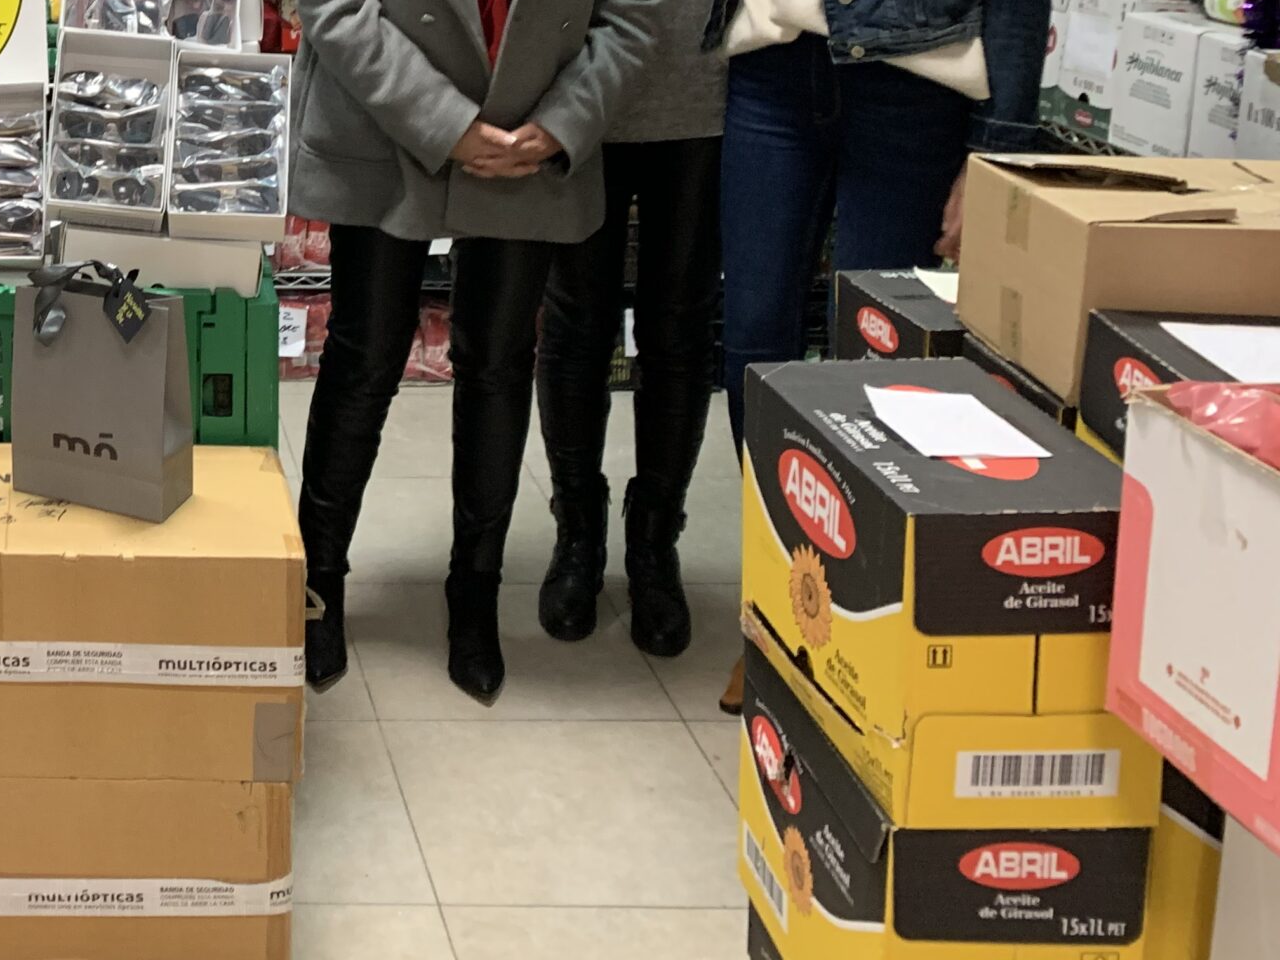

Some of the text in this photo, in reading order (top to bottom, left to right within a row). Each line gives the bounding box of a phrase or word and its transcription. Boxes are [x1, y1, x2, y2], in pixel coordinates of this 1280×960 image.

[861, 309, 894, 349] ABRIL
[785, 456, 846, 553] ABRIL
[995, 536, 1091, 566] ABRIL
[1019, 581, 1066, 594] Aceite
[1003, 595, 1080, 609] de Girasol
[974, 851, 1068, 879] ABRIL
[994, 894, 1040, 906] Aceite
[978, 907, 1054, 920] de Girasol
[1061, 918, 1126, 936] 15x1L PET
